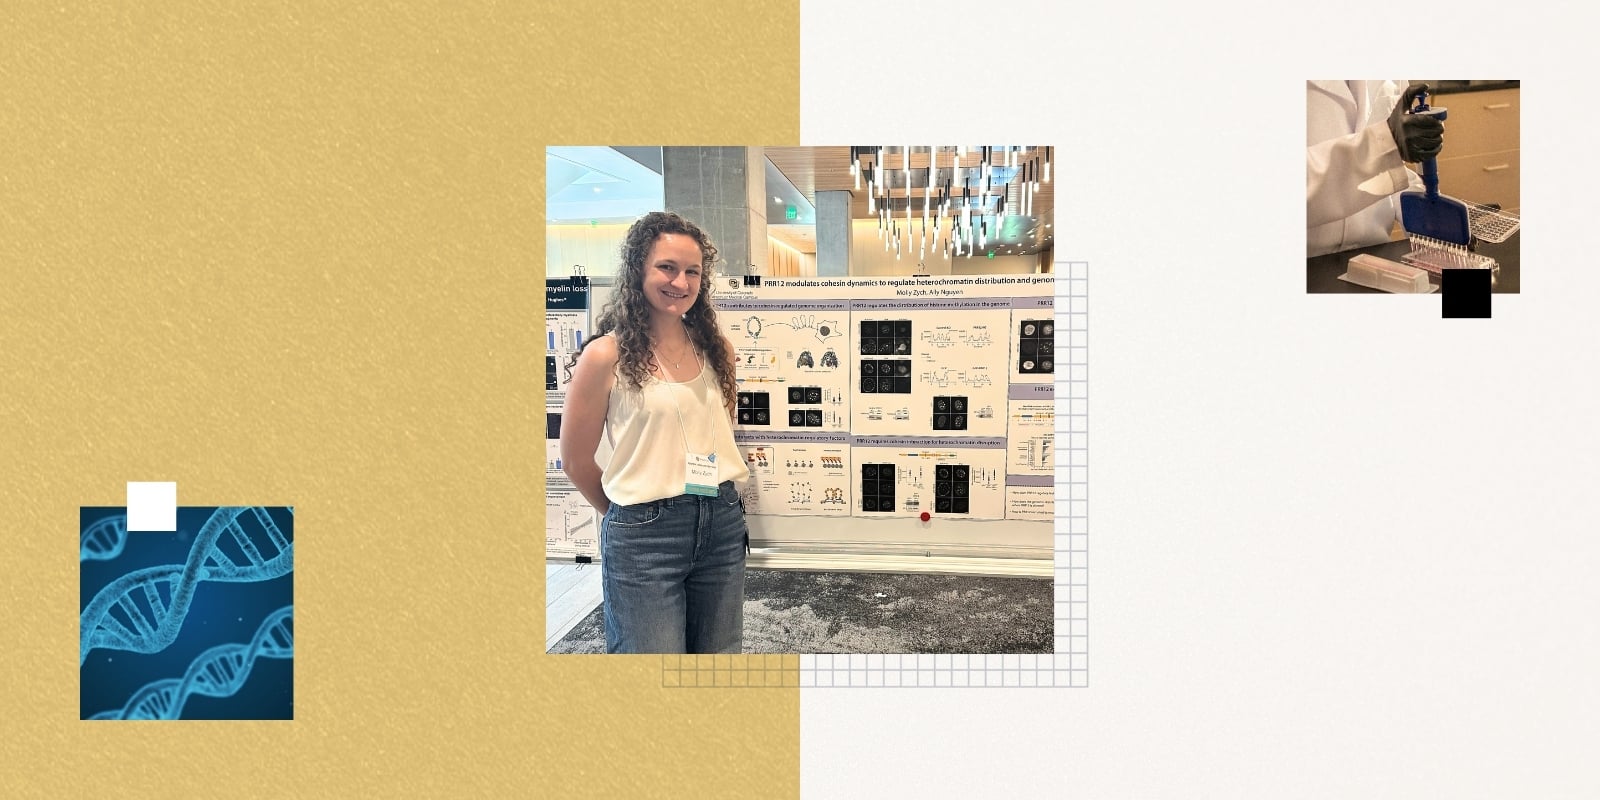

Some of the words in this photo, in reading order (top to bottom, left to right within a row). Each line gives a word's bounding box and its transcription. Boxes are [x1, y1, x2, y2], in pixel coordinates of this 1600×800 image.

[847, 279, 878, 288] dynamics
[887, 279, 915, 288] regulate
[916, 278, 973, 286] heterochromatin
[974, 277, 1016, 285] distribution
[546, 285, 571, 293] myelin
[940, 288, 964, 296] Nguyen
